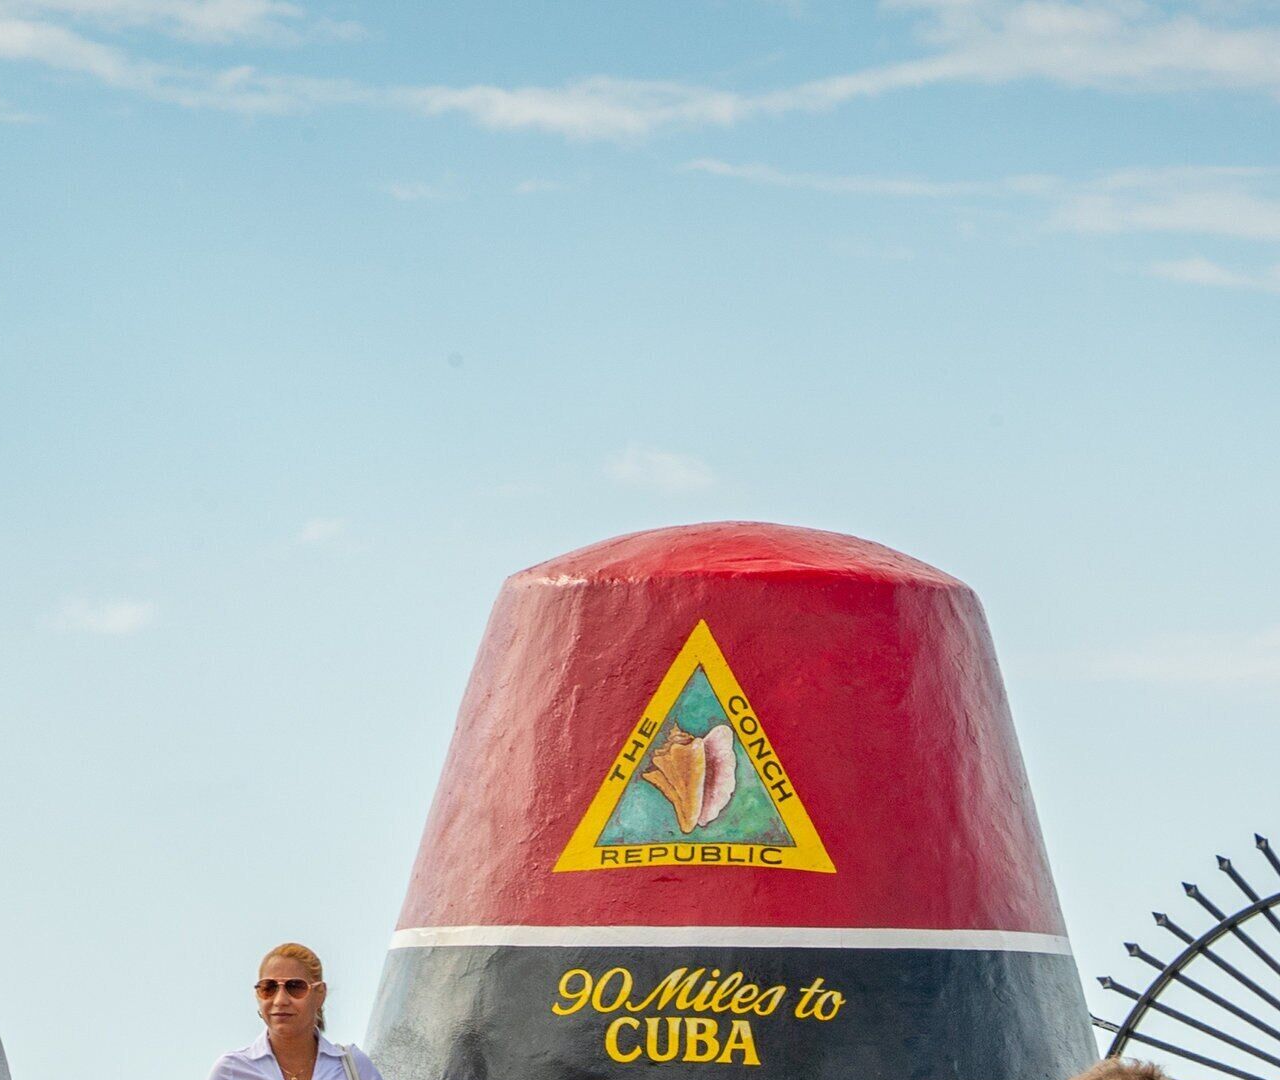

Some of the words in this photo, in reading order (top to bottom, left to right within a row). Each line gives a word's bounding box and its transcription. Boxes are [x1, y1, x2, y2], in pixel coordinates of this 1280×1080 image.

[609, 717, 658, 783] THE
[728, 695, 794, 803] CONCH
[600, 845, 783, 865] REPUBLIC
[552, 967, 634, 1017] 90
[625, 967, 787, 1017] Miles
[794, 977, 846, 1022] to
[605, 1016, 762, 1066] CUBA
